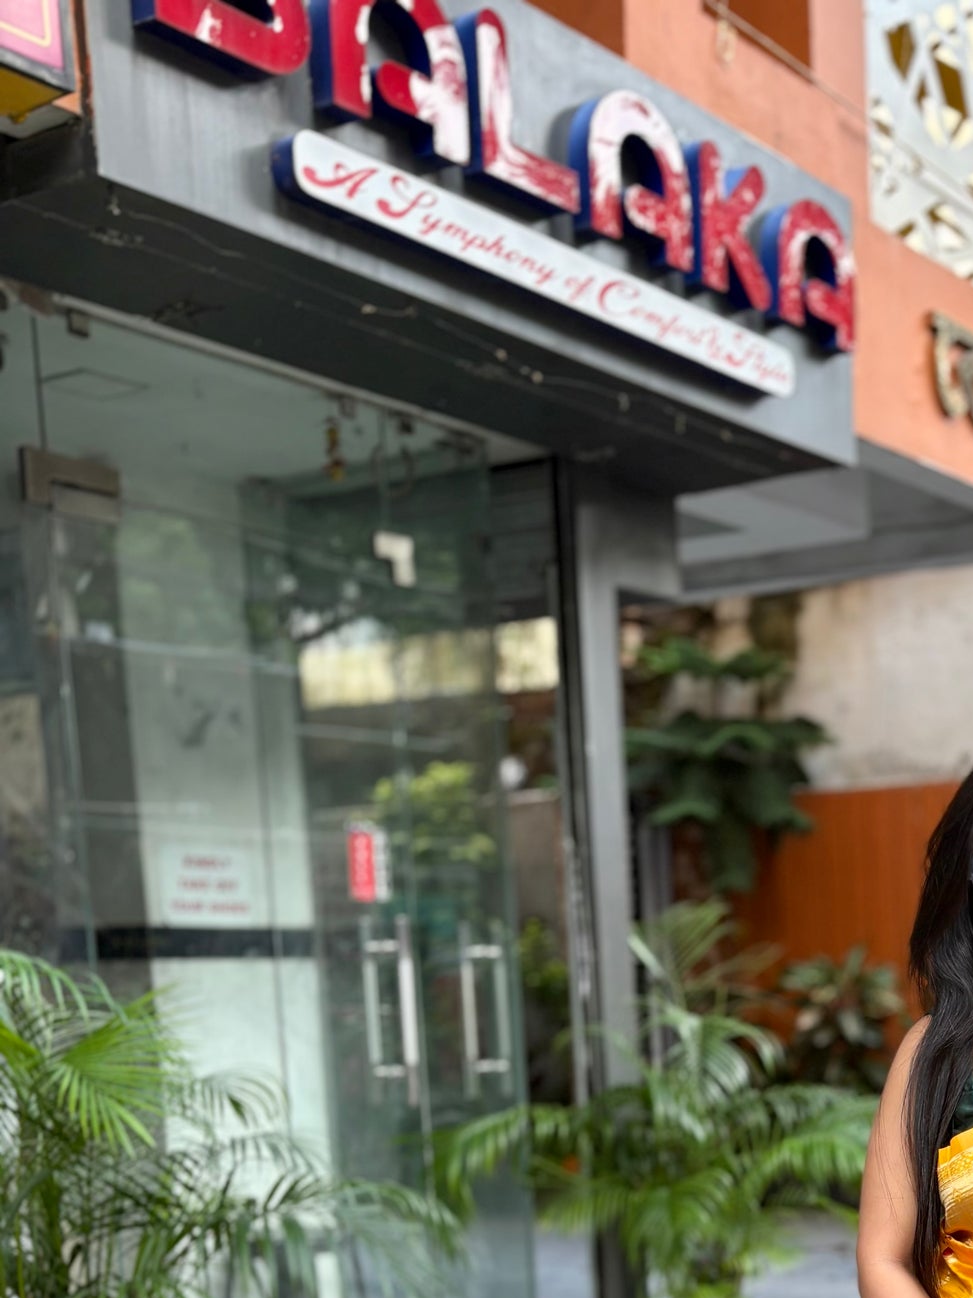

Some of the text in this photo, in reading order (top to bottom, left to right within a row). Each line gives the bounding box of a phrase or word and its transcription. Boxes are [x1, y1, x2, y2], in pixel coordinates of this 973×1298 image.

[302, 162, 379, 200] A
[376, 173, 555, 285] Symphony
[563, 275, 595, 303] of
[598, 279, 707, 345] Comfort
